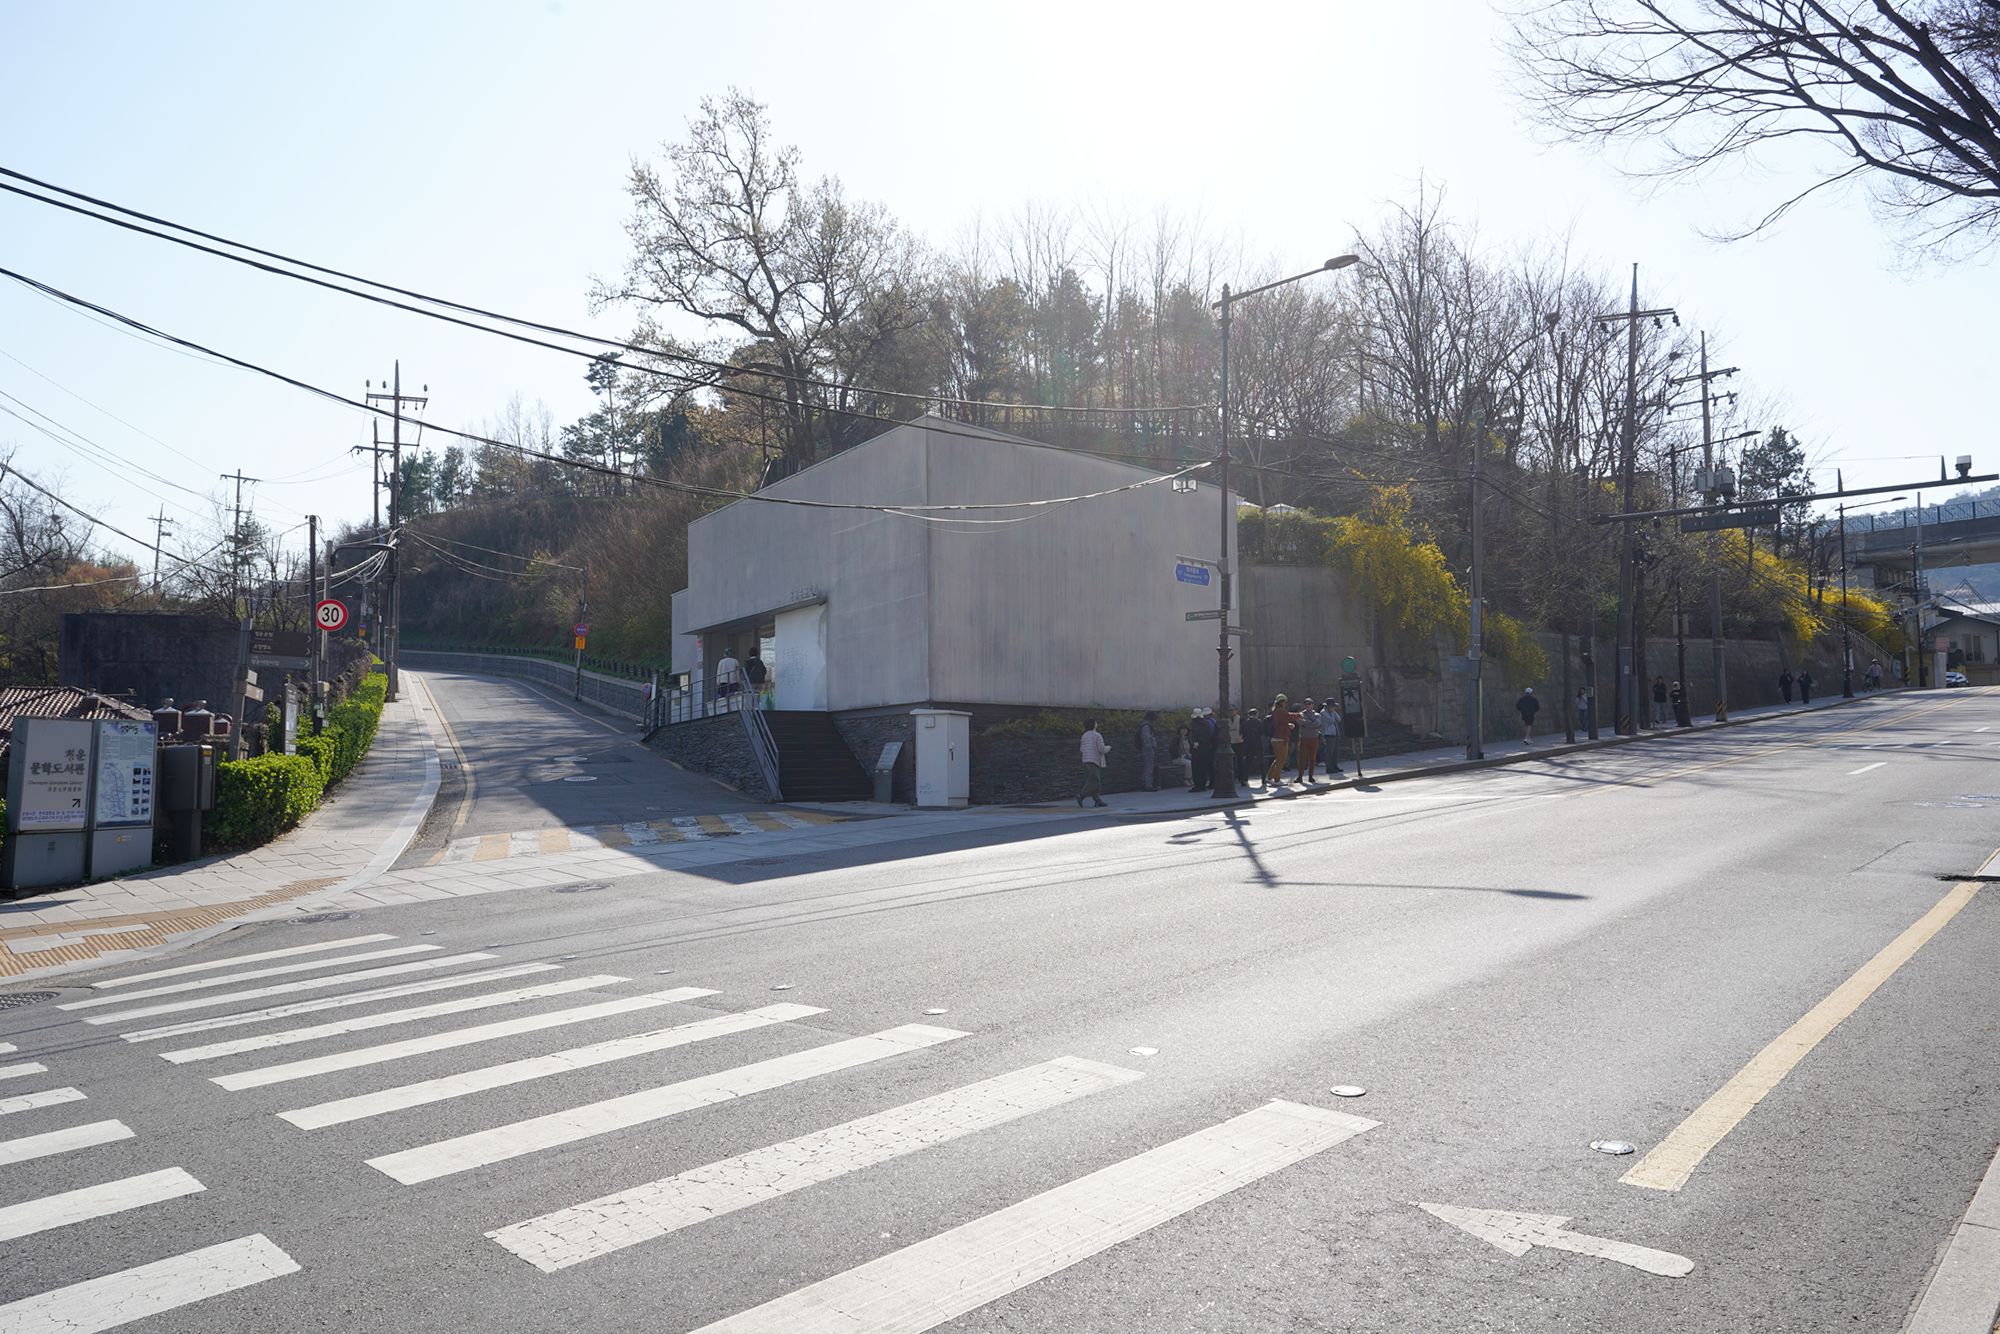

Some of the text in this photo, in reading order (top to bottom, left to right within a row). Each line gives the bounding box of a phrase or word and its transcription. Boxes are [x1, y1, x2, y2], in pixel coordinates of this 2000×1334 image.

[321, 607, 340, 623] 30
[65, 749, 86, 761] 청운
[30, 762, 85, 775] 문학도서관
